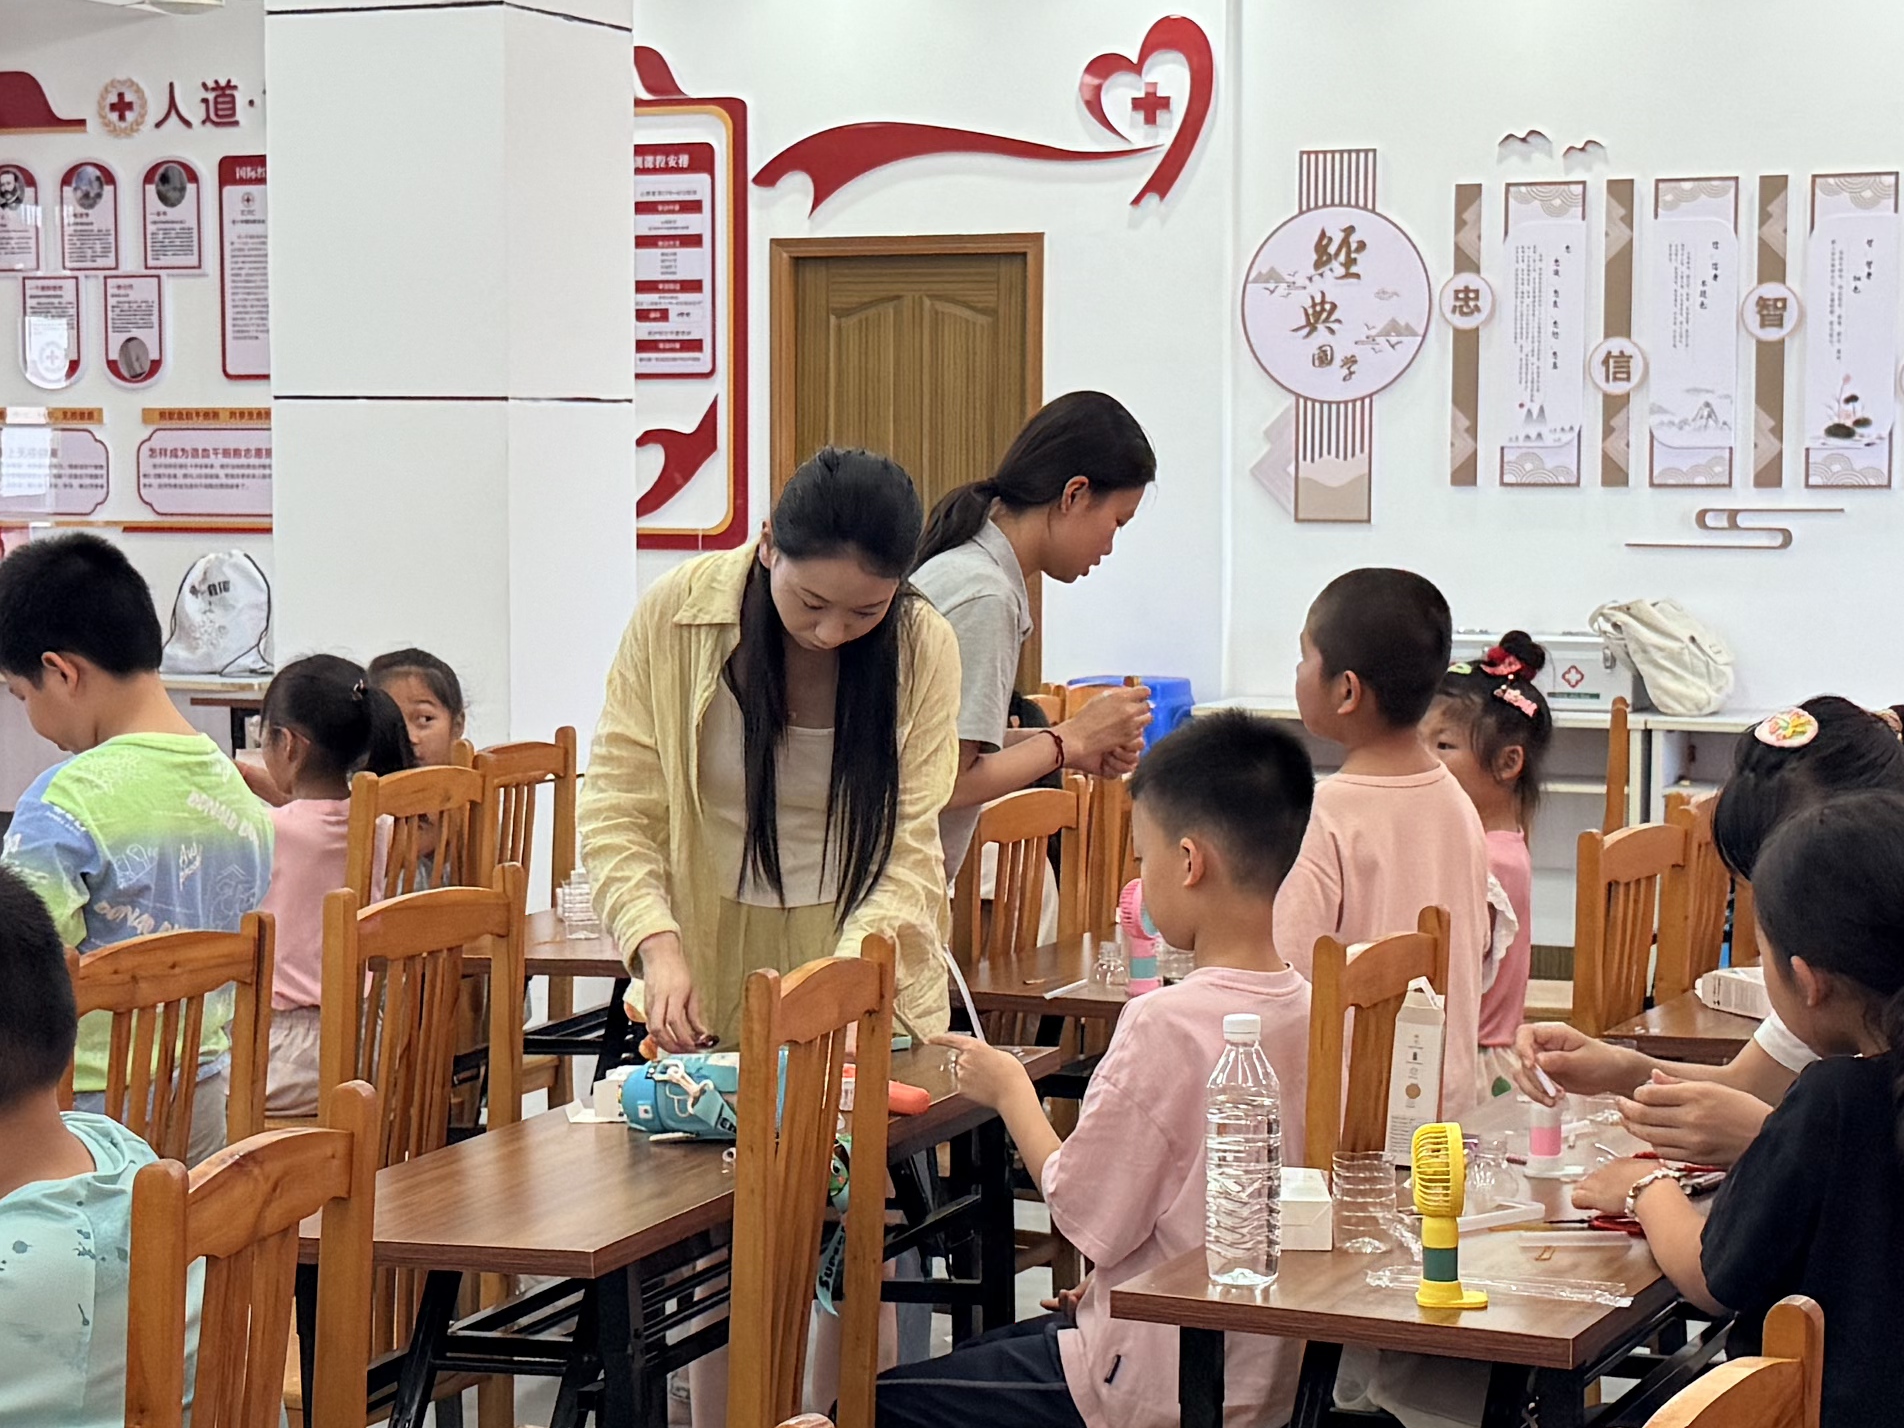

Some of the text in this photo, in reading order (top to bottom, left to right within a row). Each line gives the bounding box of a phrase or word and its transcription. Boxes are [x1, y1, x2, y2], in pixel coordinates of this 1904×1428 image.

[1451, 285, 1484, 318] 忠
[1754, 296, 1788, 329] 智
[1600, 349, 1634, 385] 信
